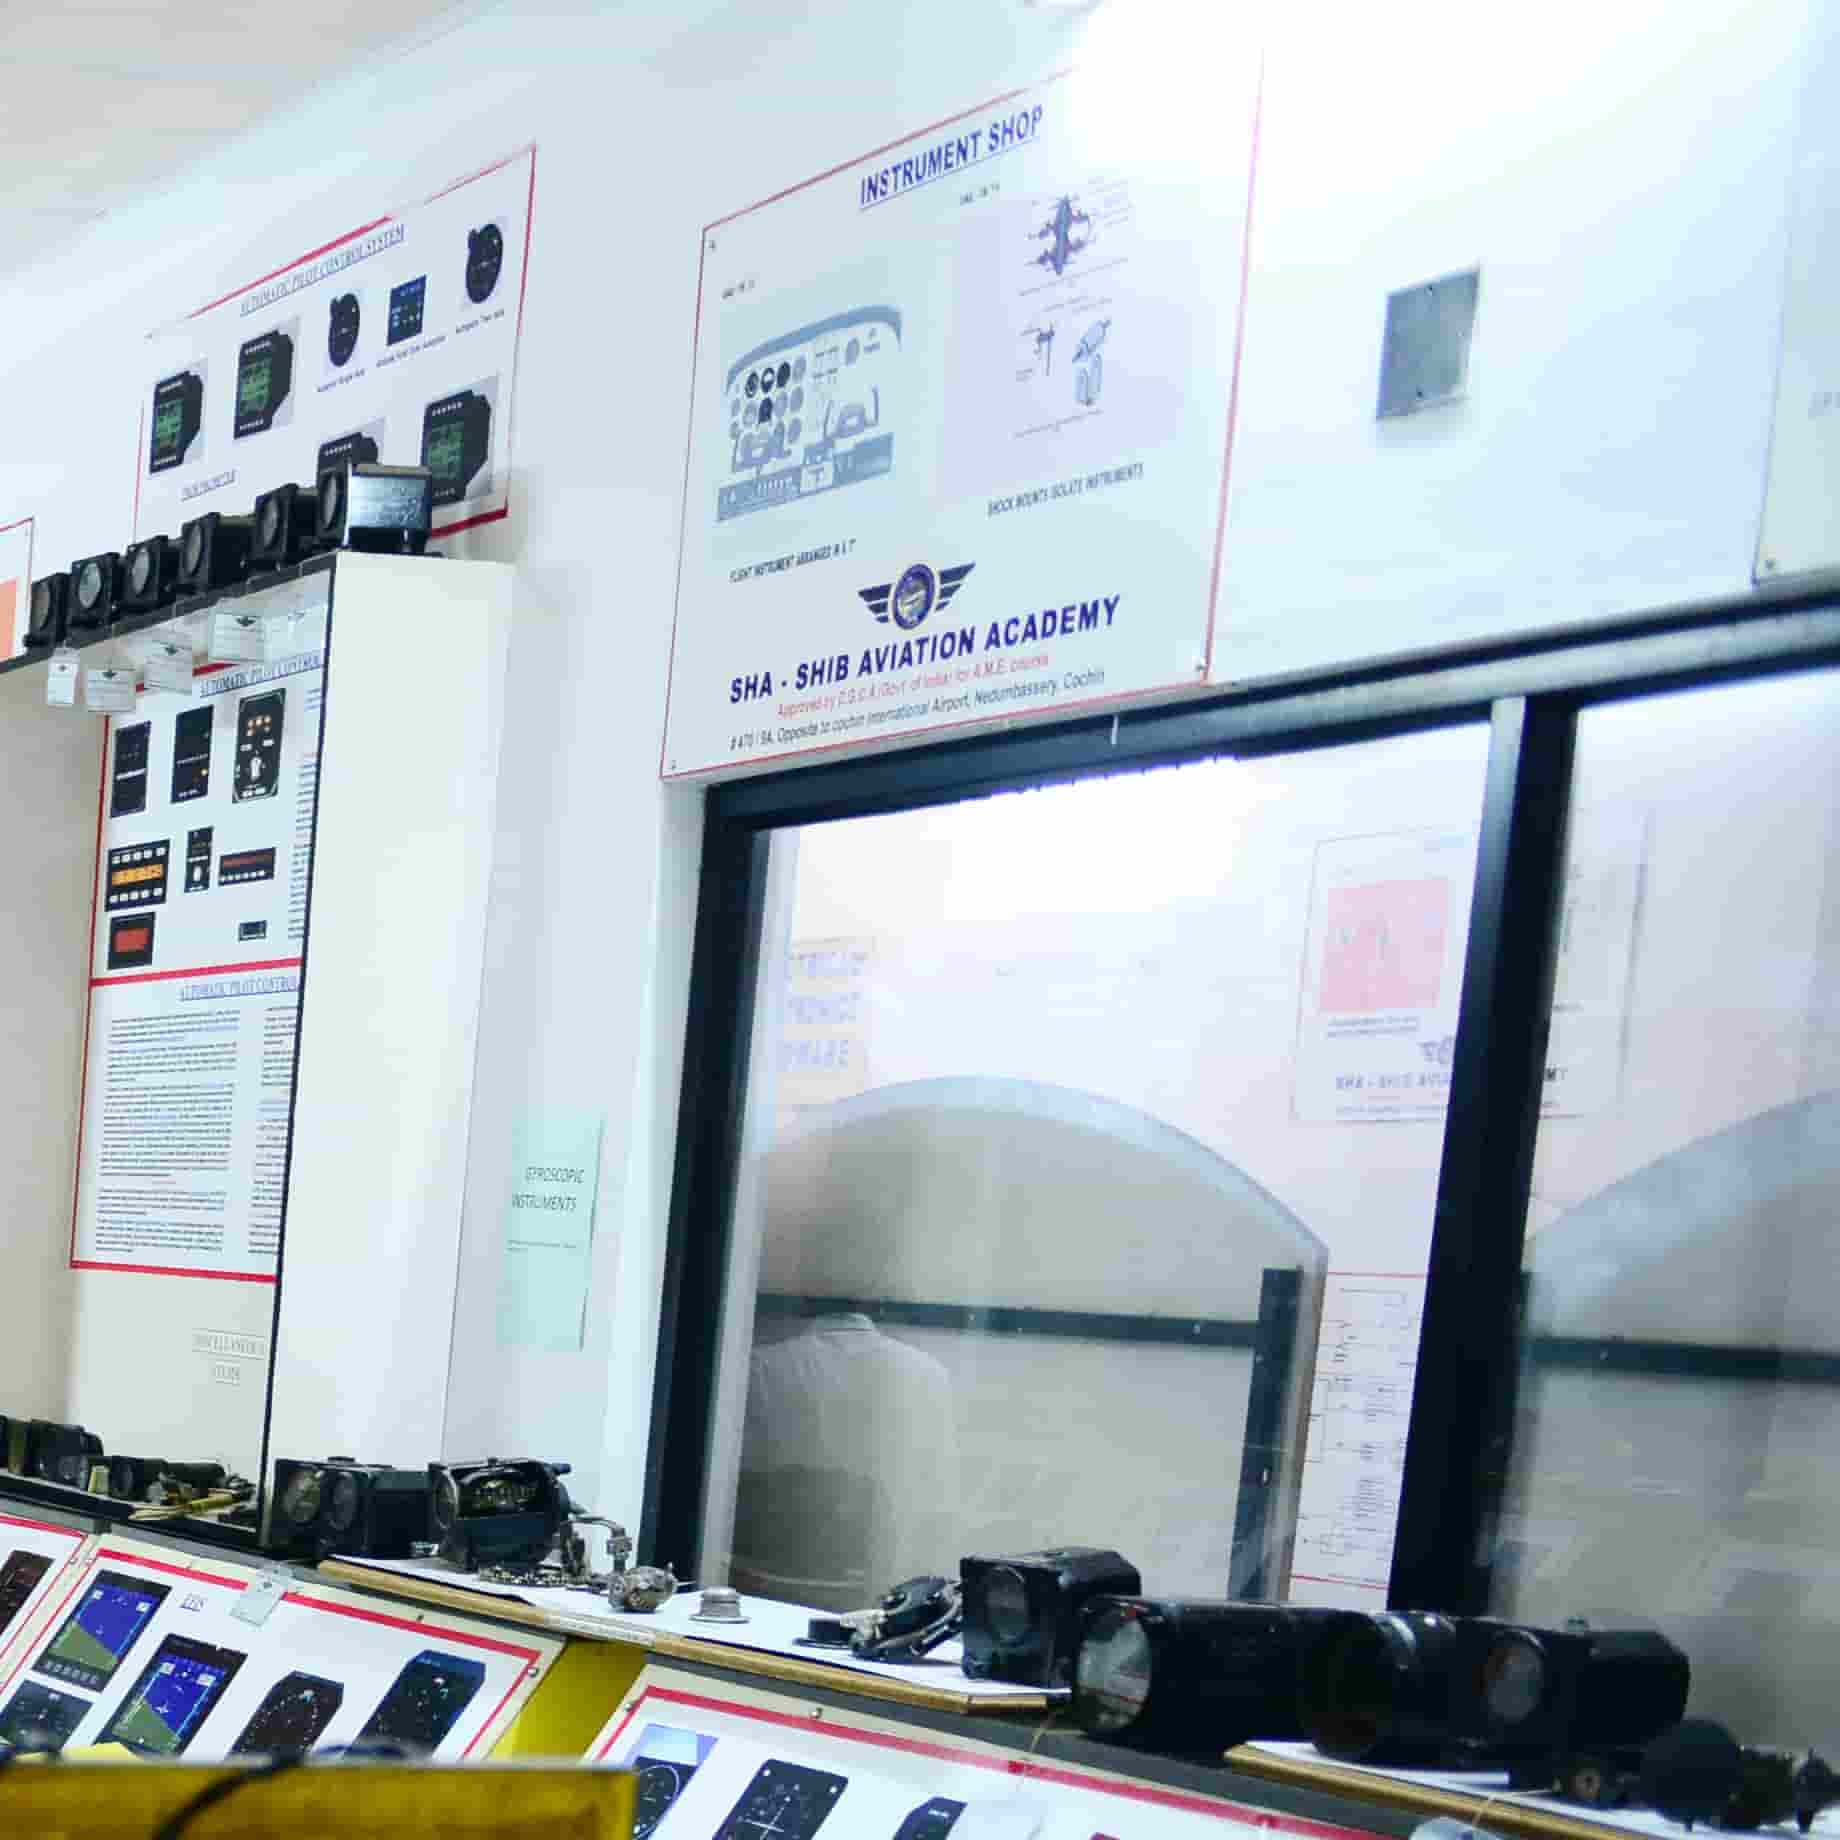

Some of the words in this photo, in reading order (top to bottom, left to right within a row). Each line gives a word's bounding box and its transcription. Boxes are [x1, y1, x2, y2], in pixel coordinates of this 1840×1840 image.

[860, 132, 983, 205] INSTRUMENT
[988, 104, 1043, 153] SHOP
[730, 672, 773, 704] SHA
[796, 654, 849, 691] SHIB
[858, 627, 976, 677] AVIATION
[984, 595, 1121, 651] ACADEMY
